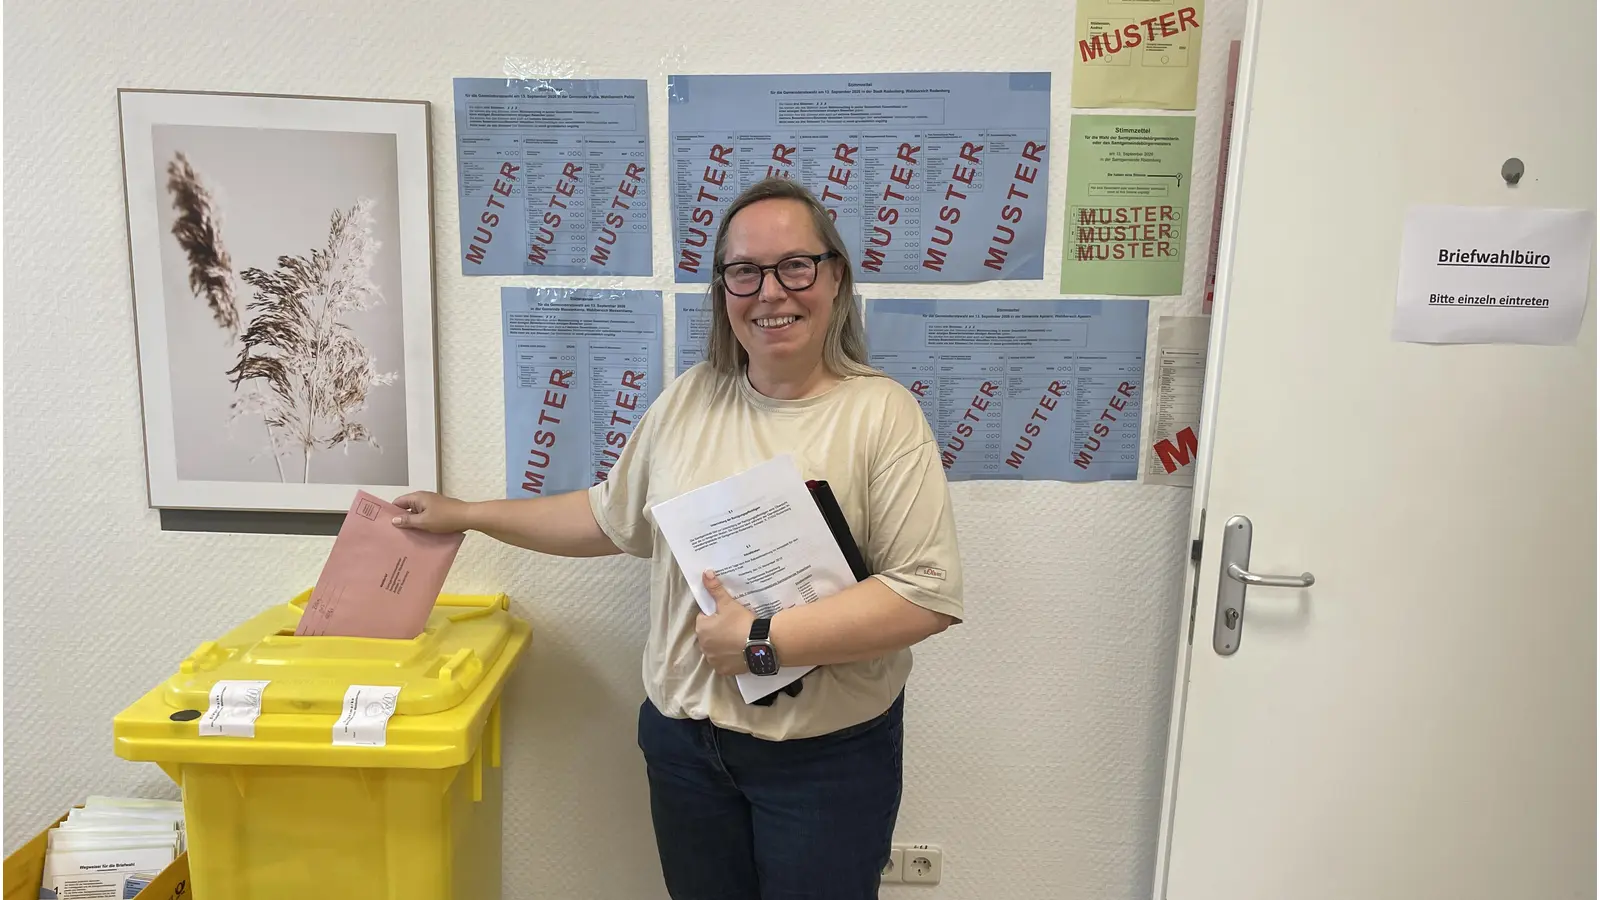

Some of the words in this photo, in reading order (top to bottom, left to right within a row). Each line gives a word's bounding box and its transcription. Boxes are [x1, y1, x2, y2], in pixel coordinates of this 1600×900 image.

[1079, 7, 1200, 62] MUSTER
[465, 162, 520, 265] MUSTER
[528, 162, 582, 266] MUSTER
[590, 162, 645, 266] MUSTER
[678, 144, 733, 274] MUSTER
[861, 142, 920, 272] MUSTER
[922, 141, 984, 272] MUSTER
[984, 141, 1046, 271] MUSTER
[1080, 206, 1172, 225] MUSTER
[1080, 224, 1171, 243] MUSTER
[1078, 242, 1170, 261] MUSTER
[1438, 249, 1550, 267] Briefwahlbüro
[1429, 294, 1455, 304] Bitte
[1457, 295, 1496, 305] einzeln
[1499, 295, 1549, 306] eintreten
[522, 368, 572, 494] MUSTER
[941, 381, 999, 470] MUSTER
[1005, 380, 1067, 470] MUSTER
[1074, 381, 1136, 470] MUSTER
[53, 886, 62, 895] 1.
